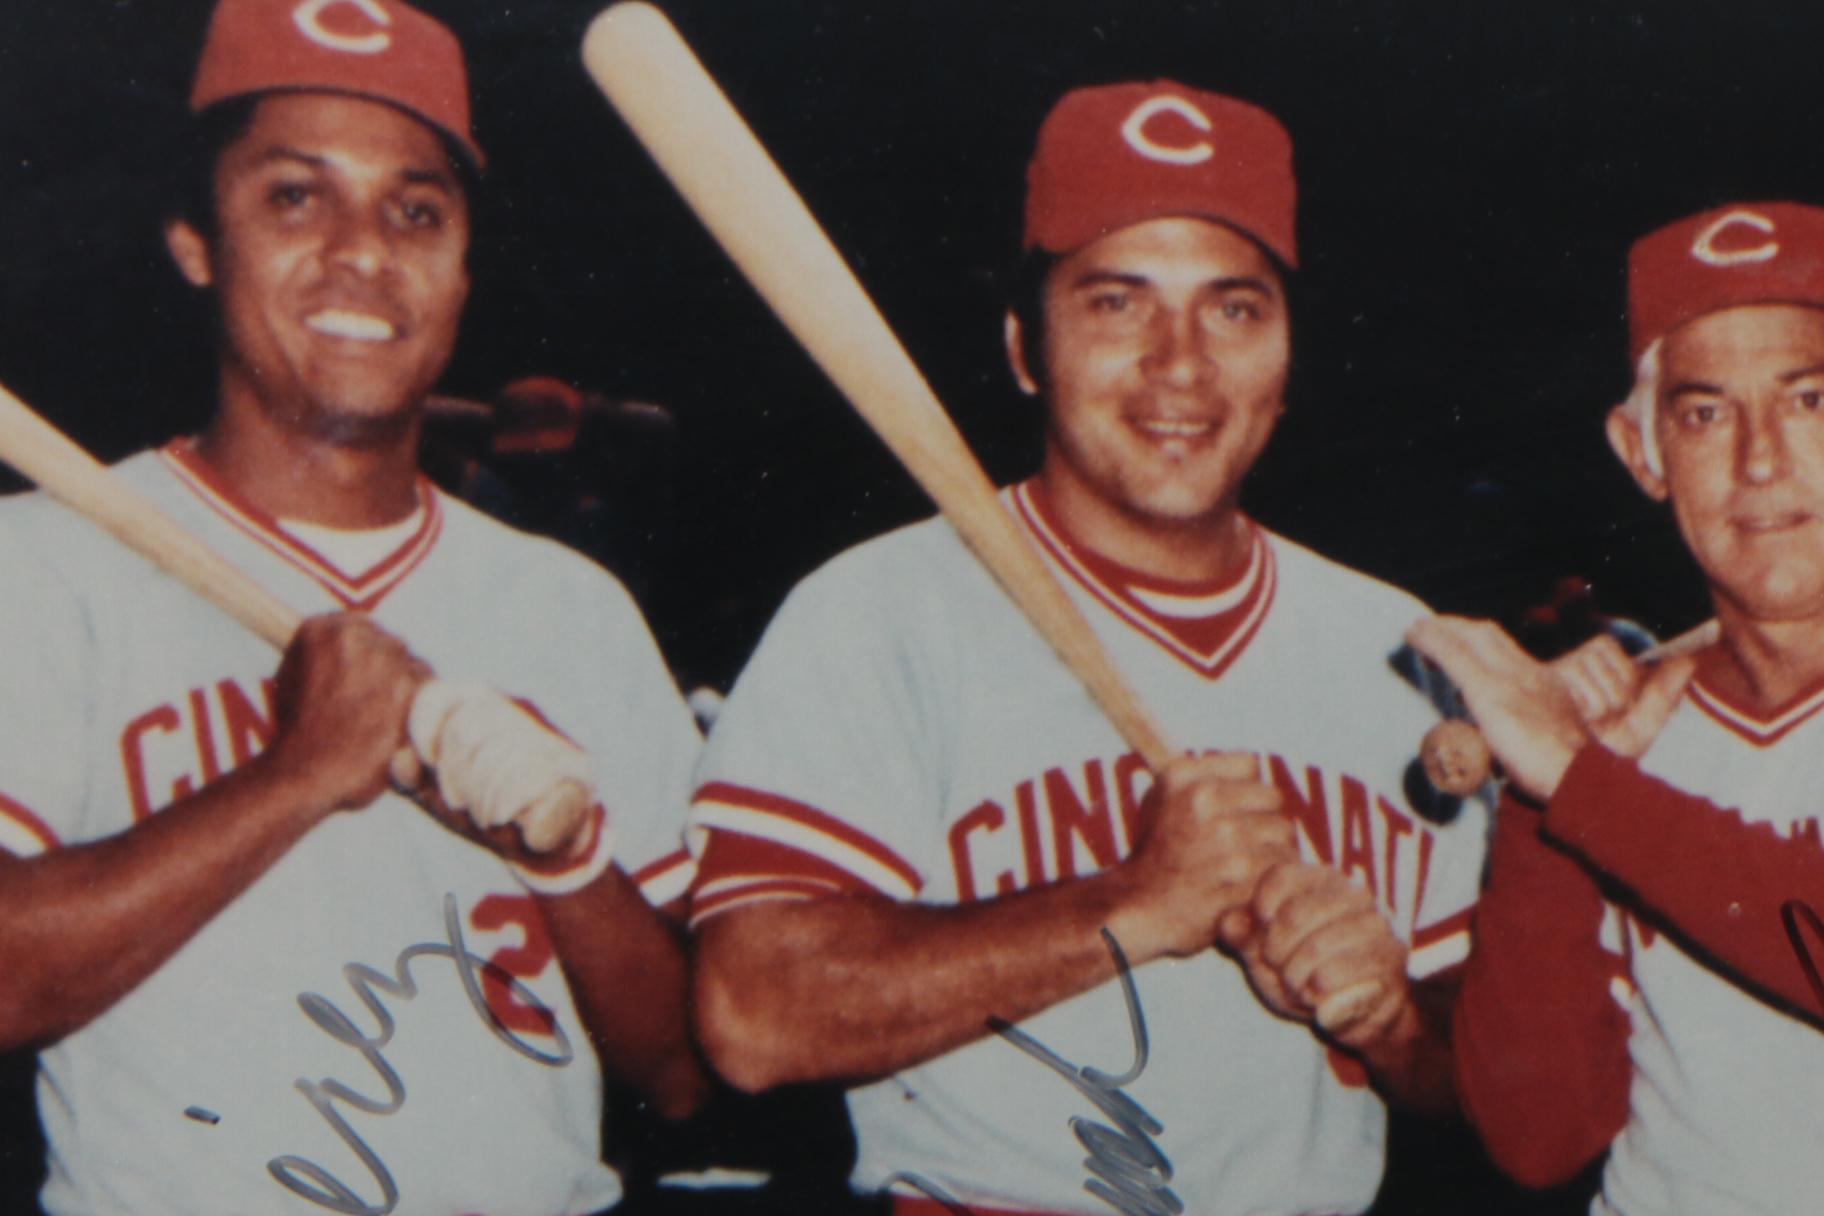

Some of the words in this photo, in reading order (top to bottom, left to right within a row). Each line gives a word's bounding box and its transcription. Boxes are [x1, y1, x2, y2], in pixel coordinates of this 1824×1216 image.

[291, 0, 393, 54] C
[1121, 95, 1215, 165] C
[1691, 210, 1779, 267] C
[118, 677, 278, 826] CIN
